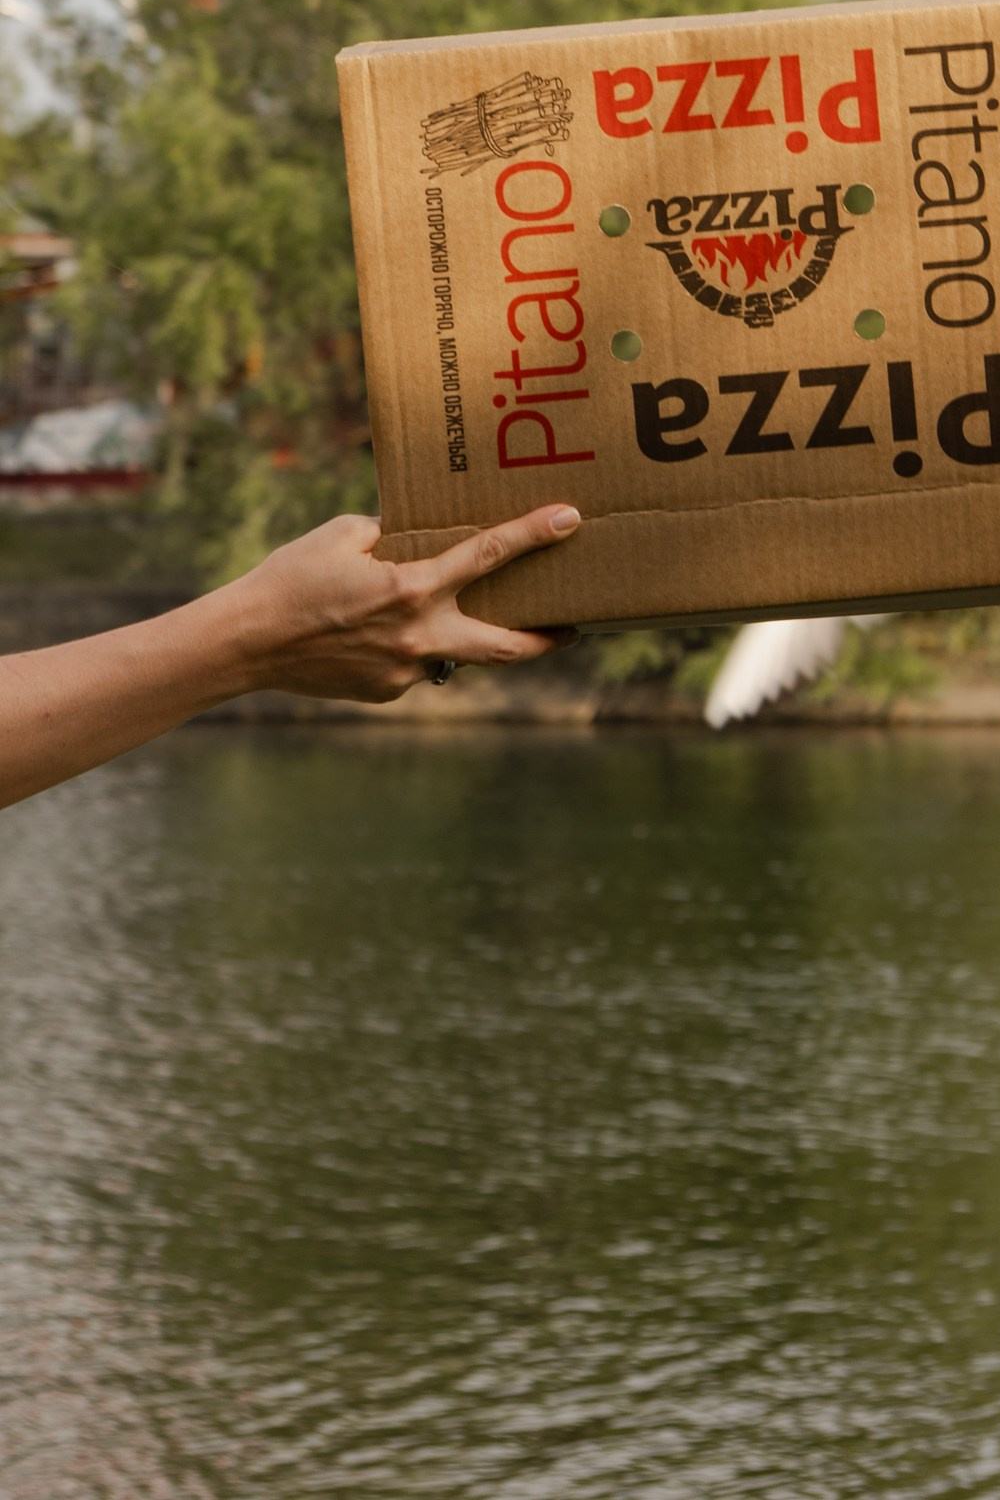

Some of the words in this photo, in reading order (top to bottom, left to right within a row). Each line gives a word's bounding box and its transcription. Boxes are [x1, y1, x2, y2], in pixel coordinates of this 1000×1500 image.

[592, 48, 882, 155] Pizza
[646, 184, 855, 241] Pizza
[903, 40, 1000, 330] Pitano
[424, 187, 450, 274] ОСТОРОЖНО
[432, 276, 455, 335] ГОРЯЧО,
[492, 160, 597, 471] Pitano
[438, 337, 461, 392] МОЖНО
[443, 394, 468, 473] ОБЖЕЧЬСЯ
